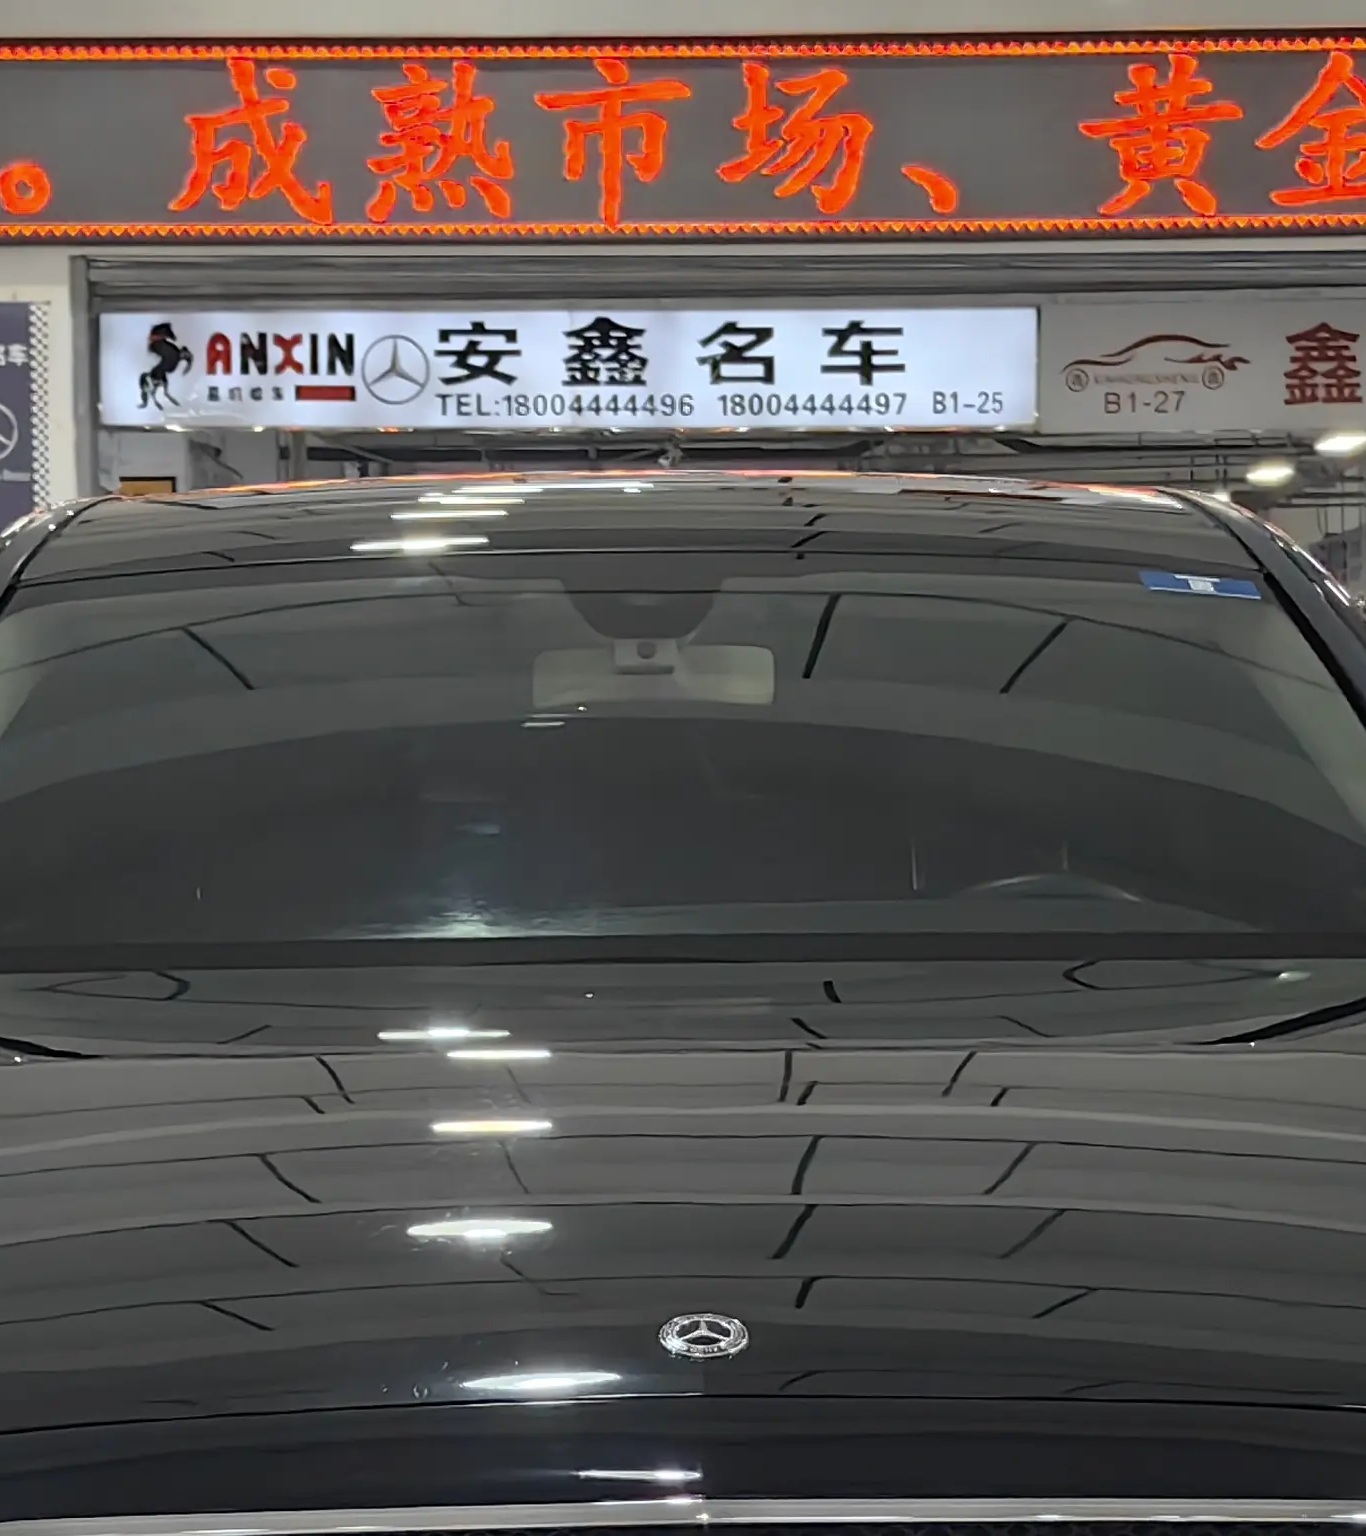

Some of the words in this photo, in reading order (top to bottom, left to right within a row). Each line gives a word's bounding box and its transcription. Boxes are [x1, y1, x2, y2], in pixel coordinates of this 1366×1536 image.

[171, 58, 957, 228] 成熟市场、
[206, 331, 355, 376] ANXIN
[434, 316, 906, 386] 安鑫名车
[435, 393, 695, 417] TEL:18004444496
[719, 393, 907, 416] 18004444497
[932, 391, 1004, 414] B1-25
[1104, 390, 1186, 414] B1-27
